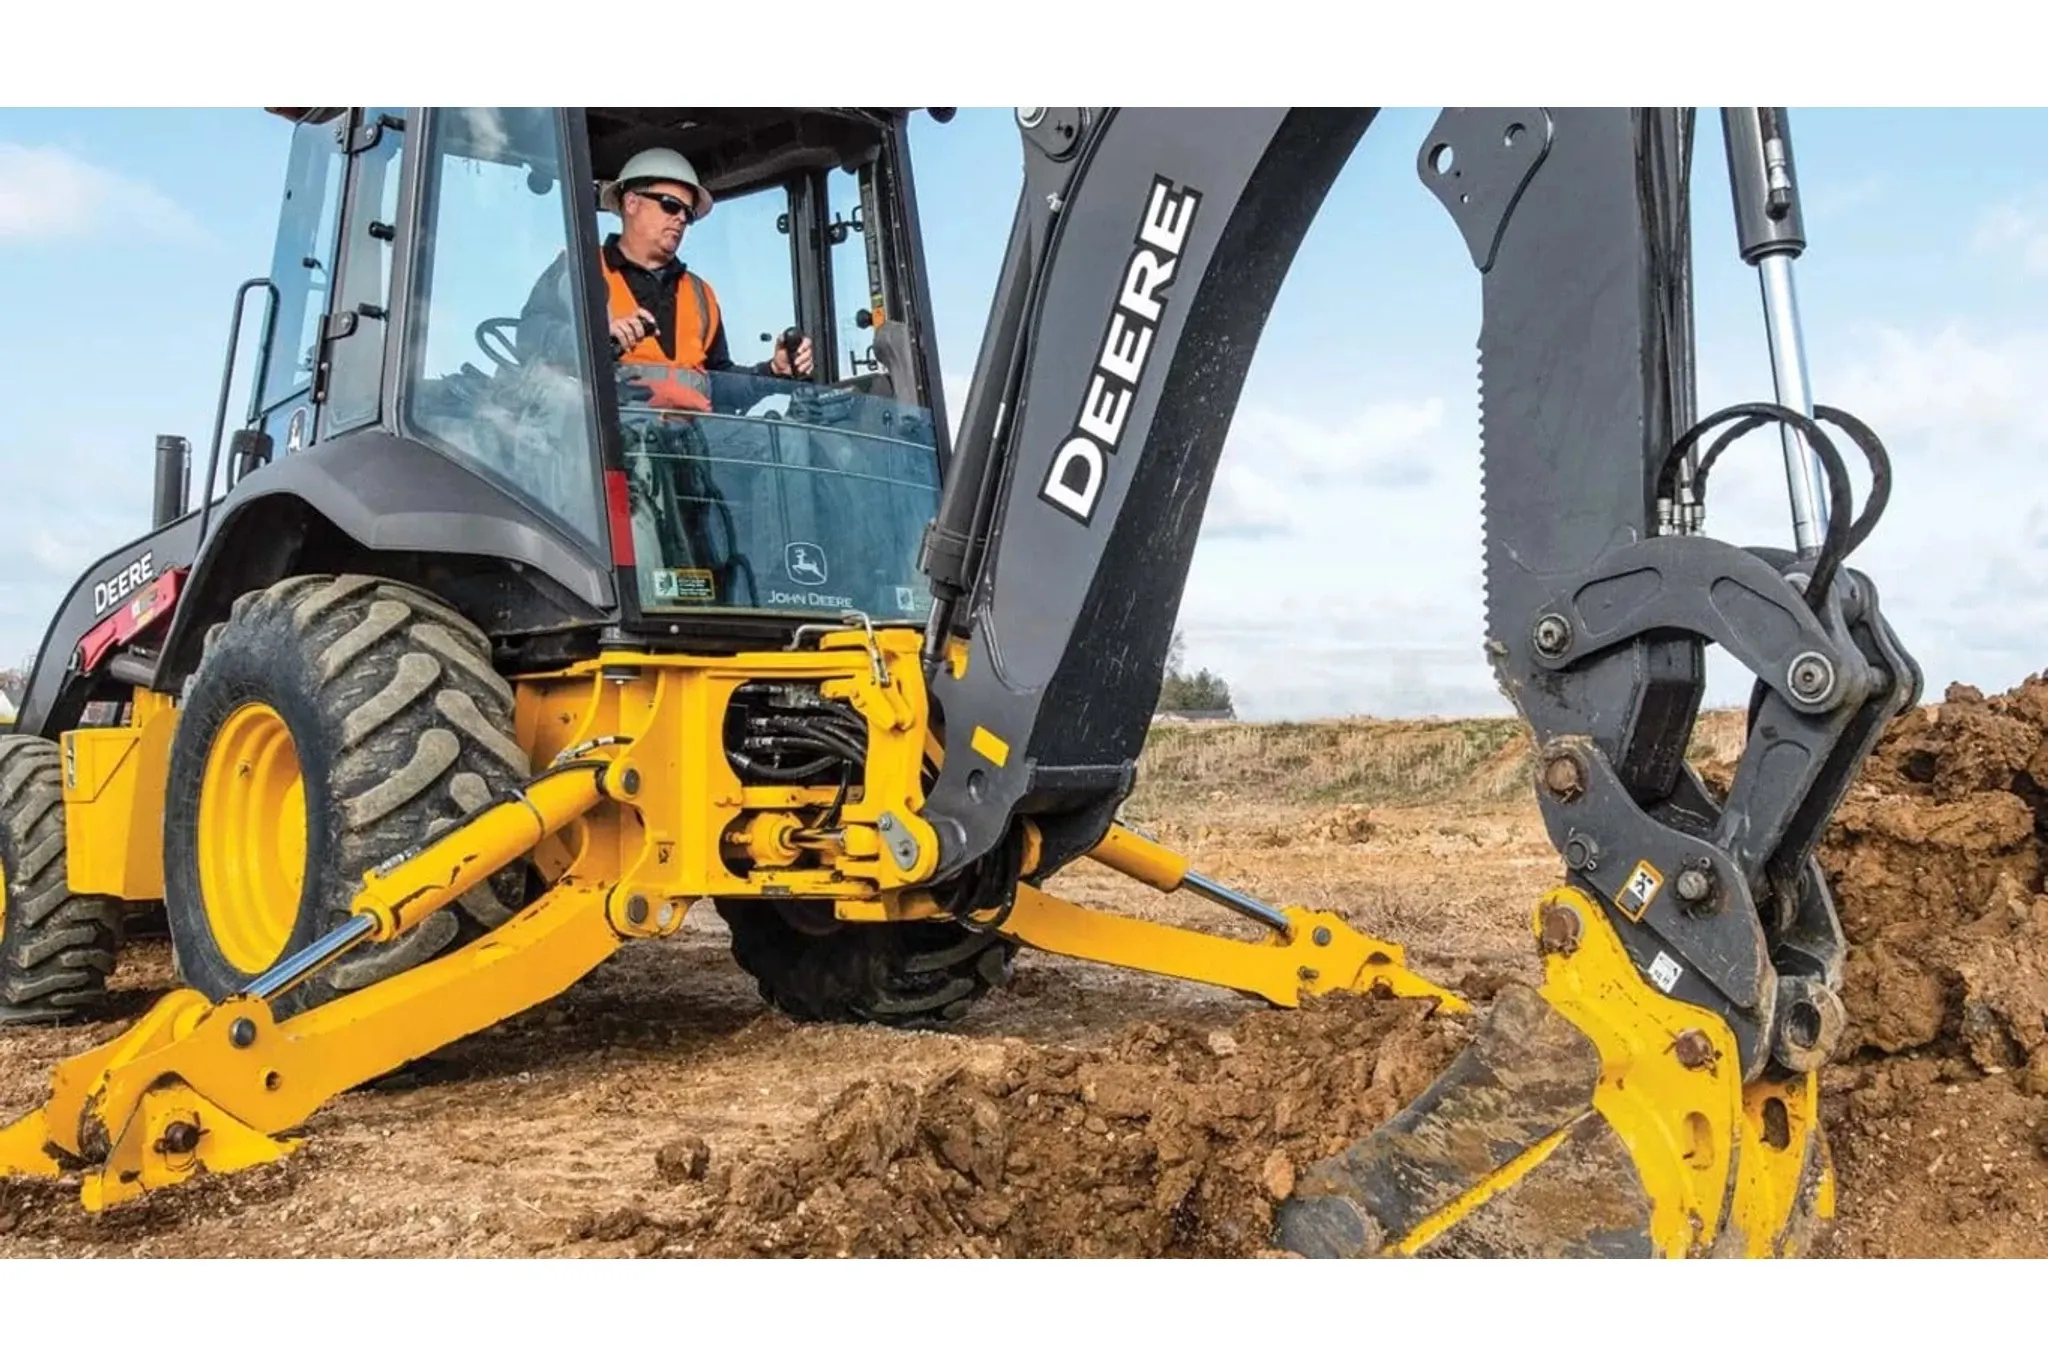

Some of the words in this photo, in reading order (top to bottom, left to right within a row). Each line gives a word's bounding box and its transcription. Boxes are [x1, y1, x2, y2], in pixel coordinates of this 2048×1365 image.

[1043, 182, 1197, 520] DEERE
[93, 551, 154, 616] DEERE
[767, 589, 807, 605] JOHN
[807, 591, 854, 608] DEERE
